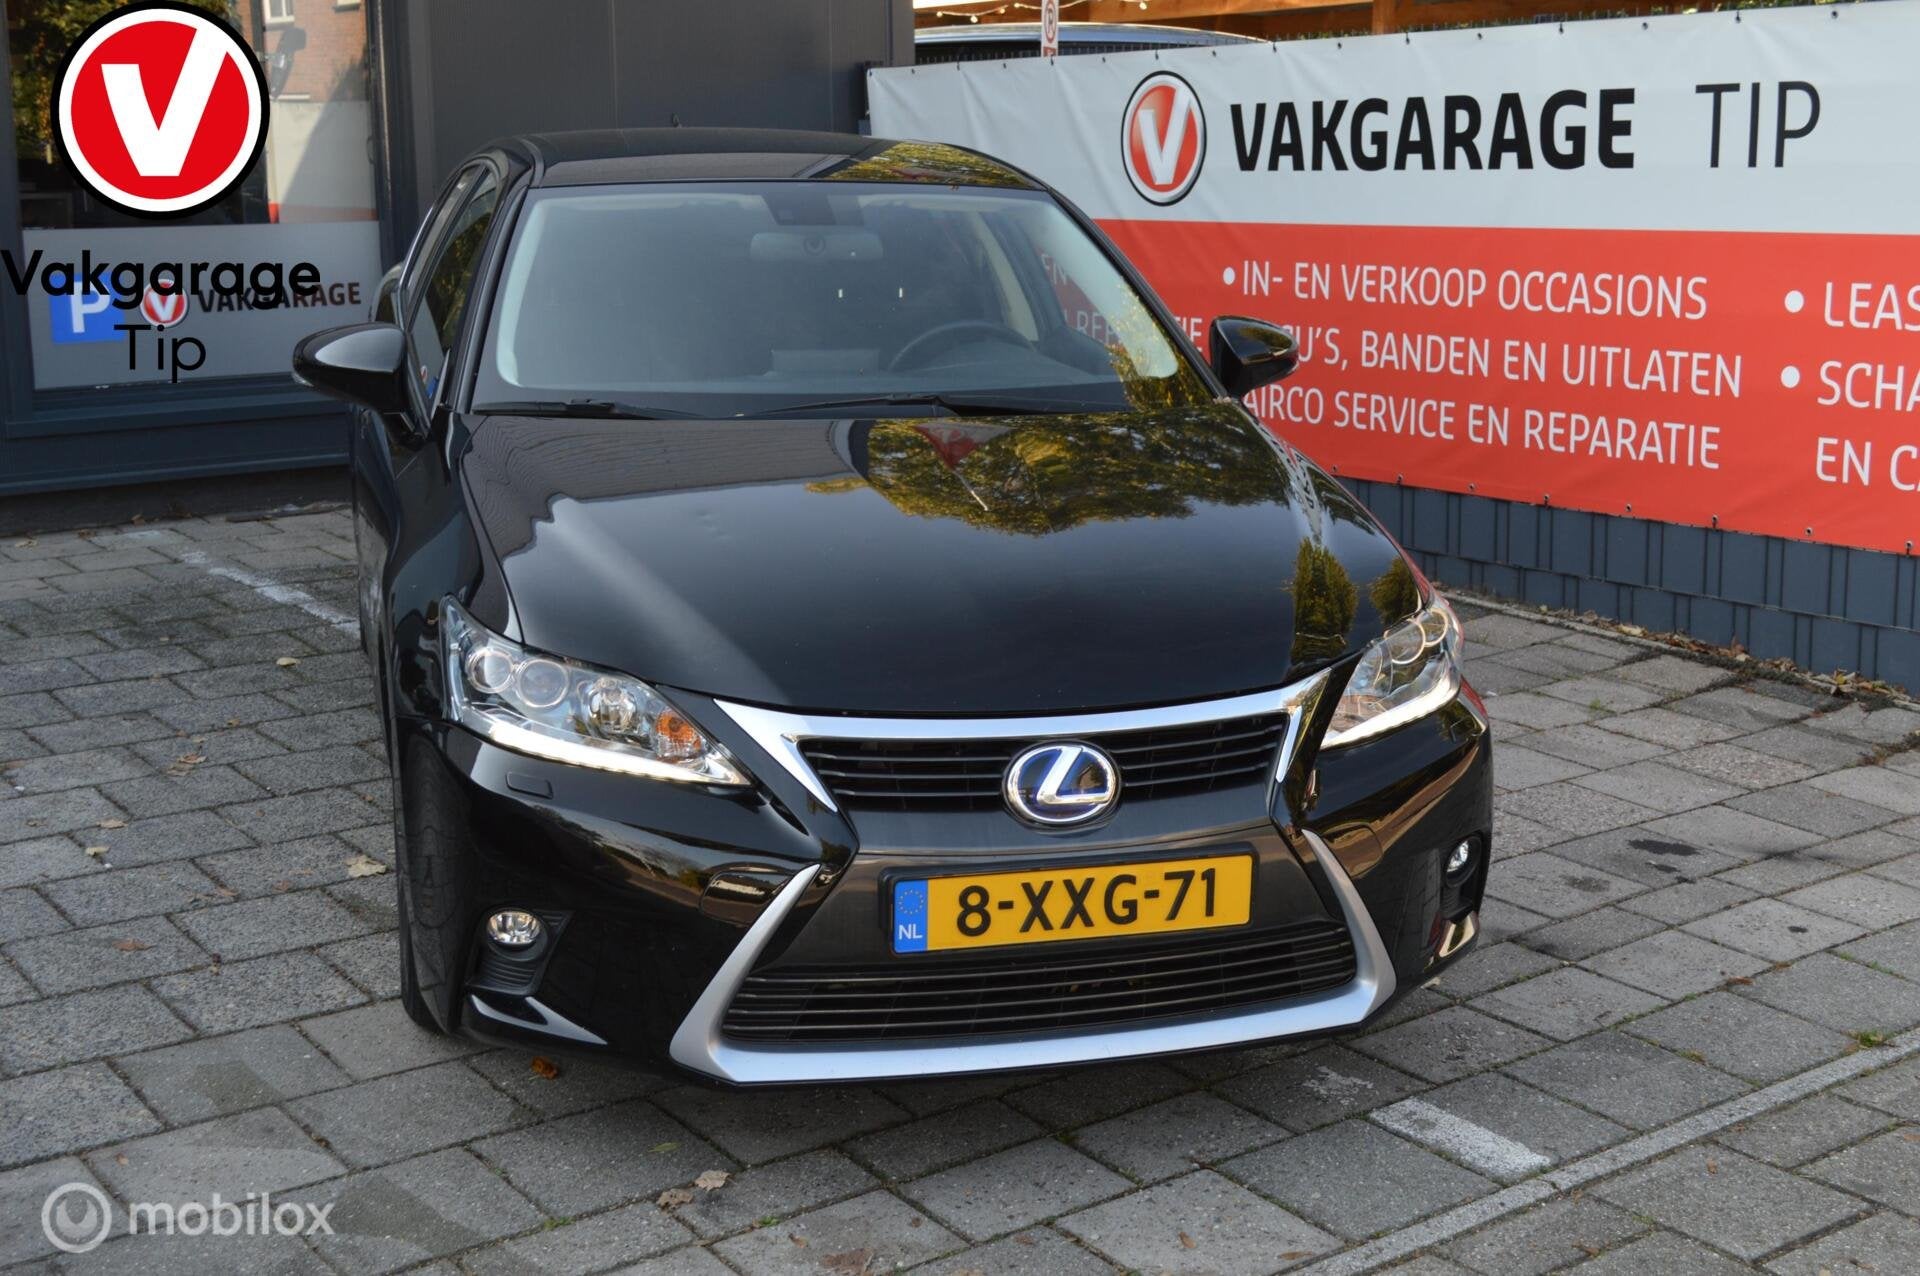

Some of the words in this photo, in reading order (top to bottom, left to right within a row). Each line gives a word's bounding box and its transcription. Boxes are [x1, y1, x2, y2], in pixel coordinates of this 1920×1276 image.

[1230, 87, 1635, 172] VAKGARAGE
[1695, 80, 1821, 168] TIP
[199, 282, 361, 313] VAKARAGE
[1243, 260, 1283, 296] IN-
[1294, 262, 1330, 299] EN
[1341, 264, 1487, 308] VERKOOP
[1498, 269, 1708, 320] OCCASIONS
[1361, 330, 1490, 378] BANDEN
[1503, 340, 1547, 383] EN
[1562, 344, 1742, 398] UITLATEN
[1243, 384, 1324, 424] AIRCO
[1333, 391, 1456, 440] SERVICE
[1468, 404, 1510, 446] EN
[1524, 409, 1721, 469] REPARATIE
[1815, 436, 1872, 486] EN
[1889, 445, 1920, 492] C
[898, 923, 922, 940] NL
[956, 867, 1217, 938] 8-XXG-71
